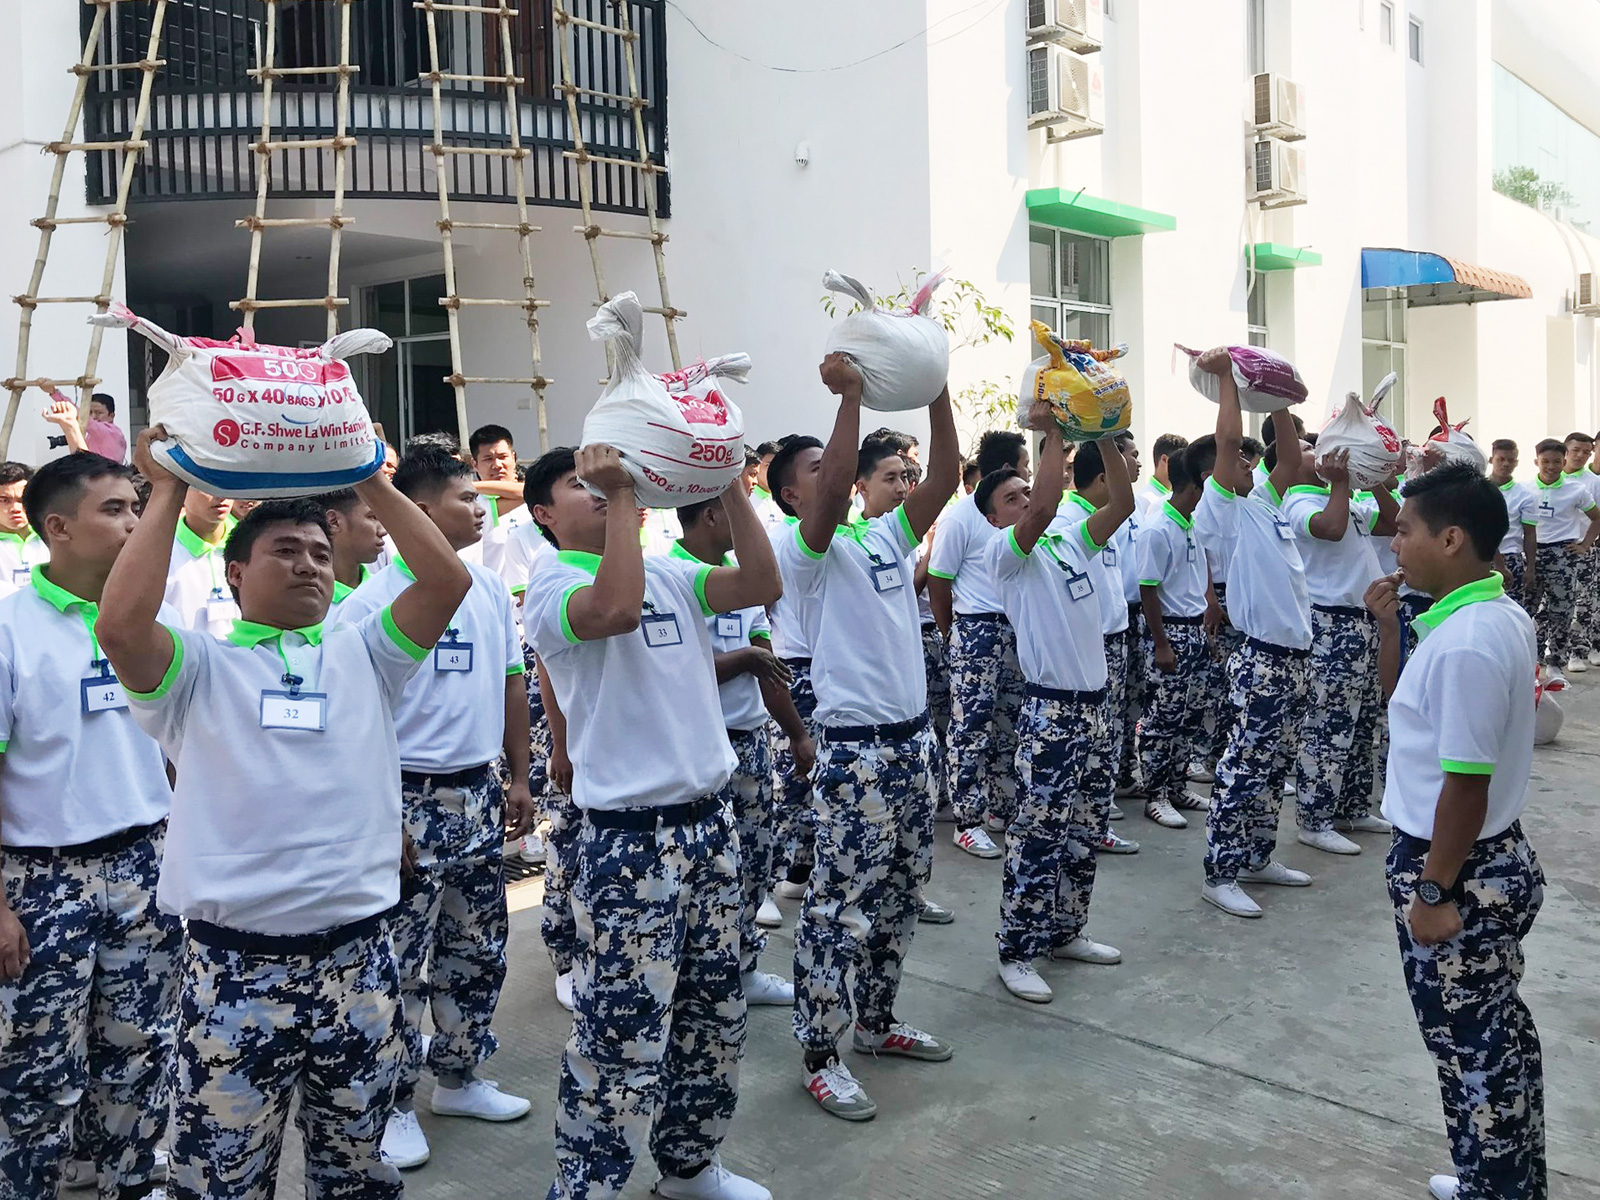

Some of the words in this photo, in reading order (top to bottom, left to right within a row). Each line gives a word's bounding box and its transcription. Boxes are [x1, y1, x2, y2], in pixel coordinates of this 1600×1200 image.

[261, 388, 285, 405] 40
[287, 394, 316, 407] BAGS
[267, 422, 305, 438] Shwe
[305, 425, 318, 438] La
[319, 423, 342, 437] Win
[240, 439, 315, 453] Company
[885, 575, 893, 583] 34
[658, 628, 668, 637] 33
[449, 656, 459, 664] 43
[103, 691, 115, 702] 42
[283, 708, 299, 719] 32
